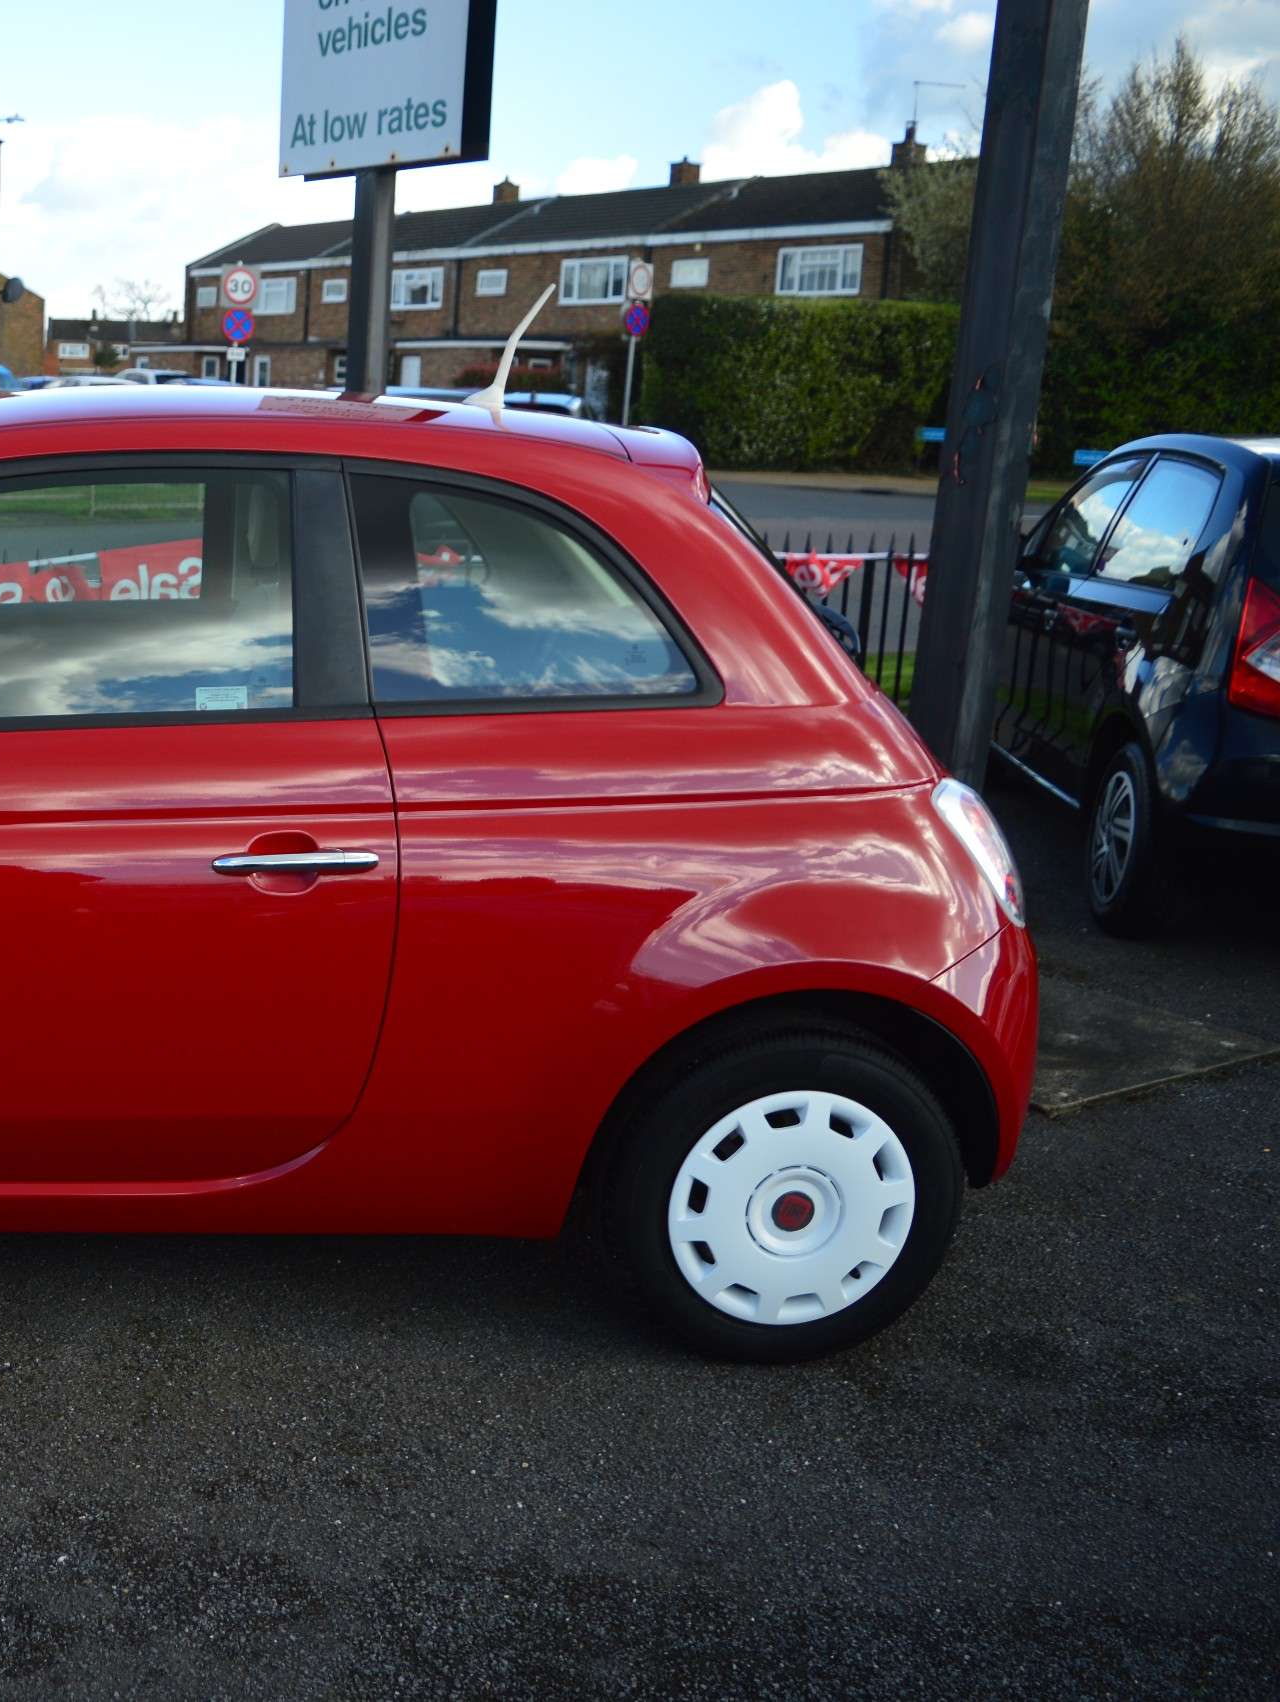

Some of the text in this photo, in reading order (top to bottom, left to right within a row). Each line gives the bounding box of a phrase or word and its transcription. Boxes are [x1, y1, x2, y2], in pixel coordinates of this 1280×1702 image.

[318, 7, 427, 57] vehicles
[290, 97, 448, 148] At low rates
[230, 279, 252, 294] 30
